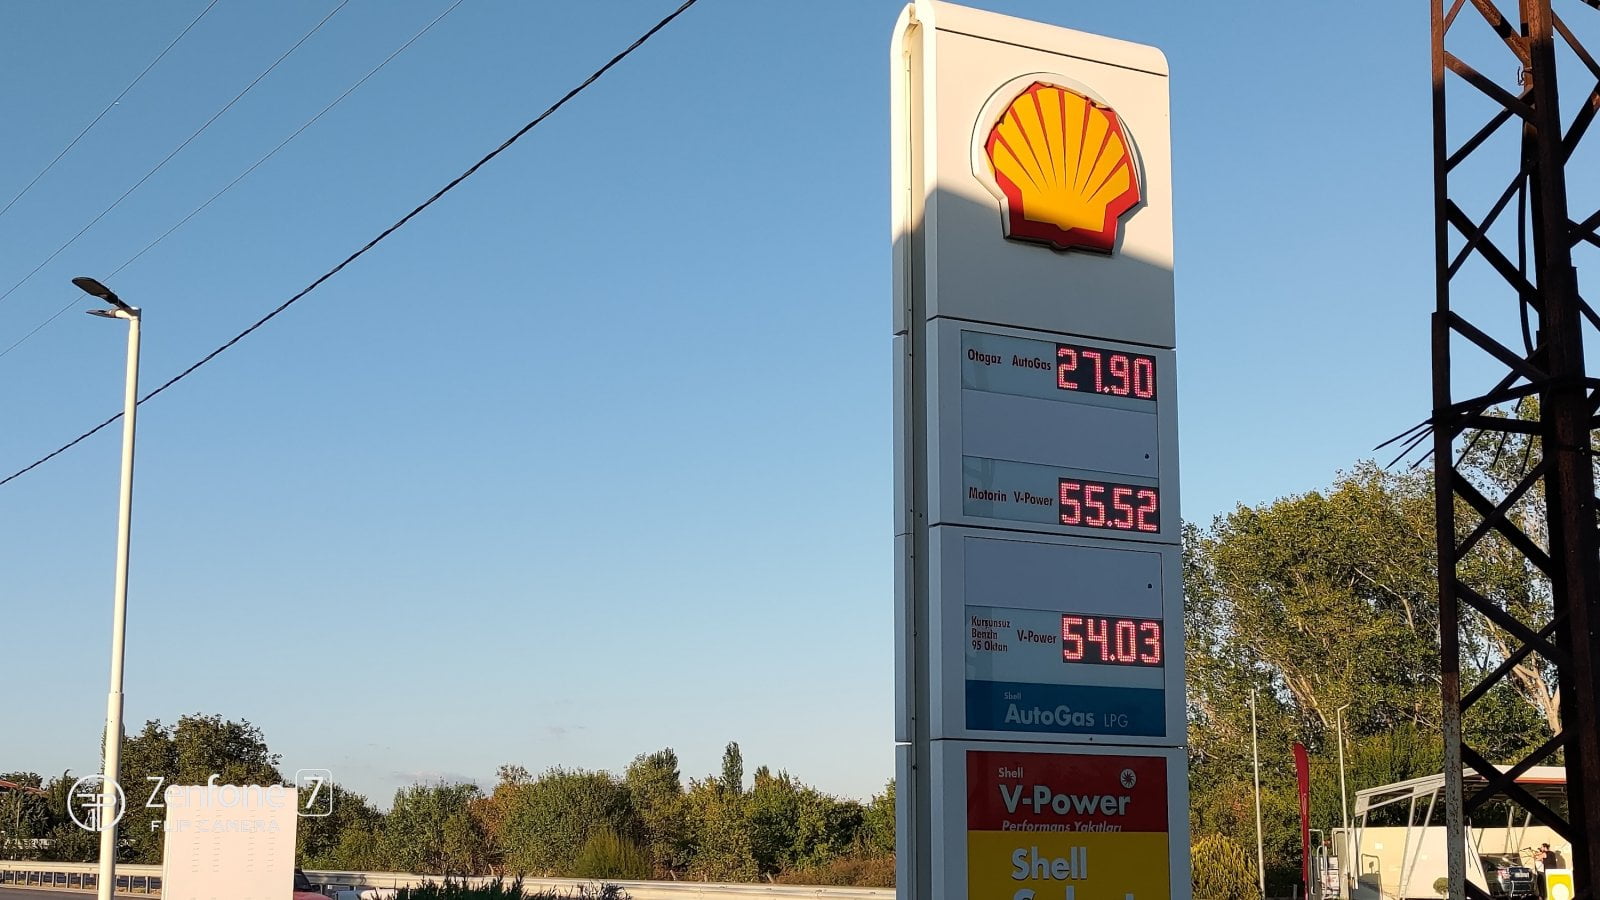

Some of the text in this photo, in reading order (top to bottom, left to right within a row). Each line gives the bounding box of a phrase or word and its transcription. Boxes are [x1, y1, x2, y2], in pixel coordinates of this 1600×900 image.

[968, 349, 1051, 370] Otogaz AutoGas
[1058, 348, 1153, 398] 27.90
[969, 487, 1053, 506] Motorin V-Power
[1061, 482, 1157, 531] 55.52
[971, 628, 998, 640] Benzin
[1017, 629, 1057, 644] V-Power
[1062, 617, 1160, 663] 54.03
[971, 640, 981, 650] 95
[1004, 703, 1129, 728] AutoGas LPG
[999, 767, 1024, 778] Shell
[999, 784, 1131, 816] V-Power
[1002, 820, 1070, 832] Performans
[1011, 847, 1088, 881] Shell
